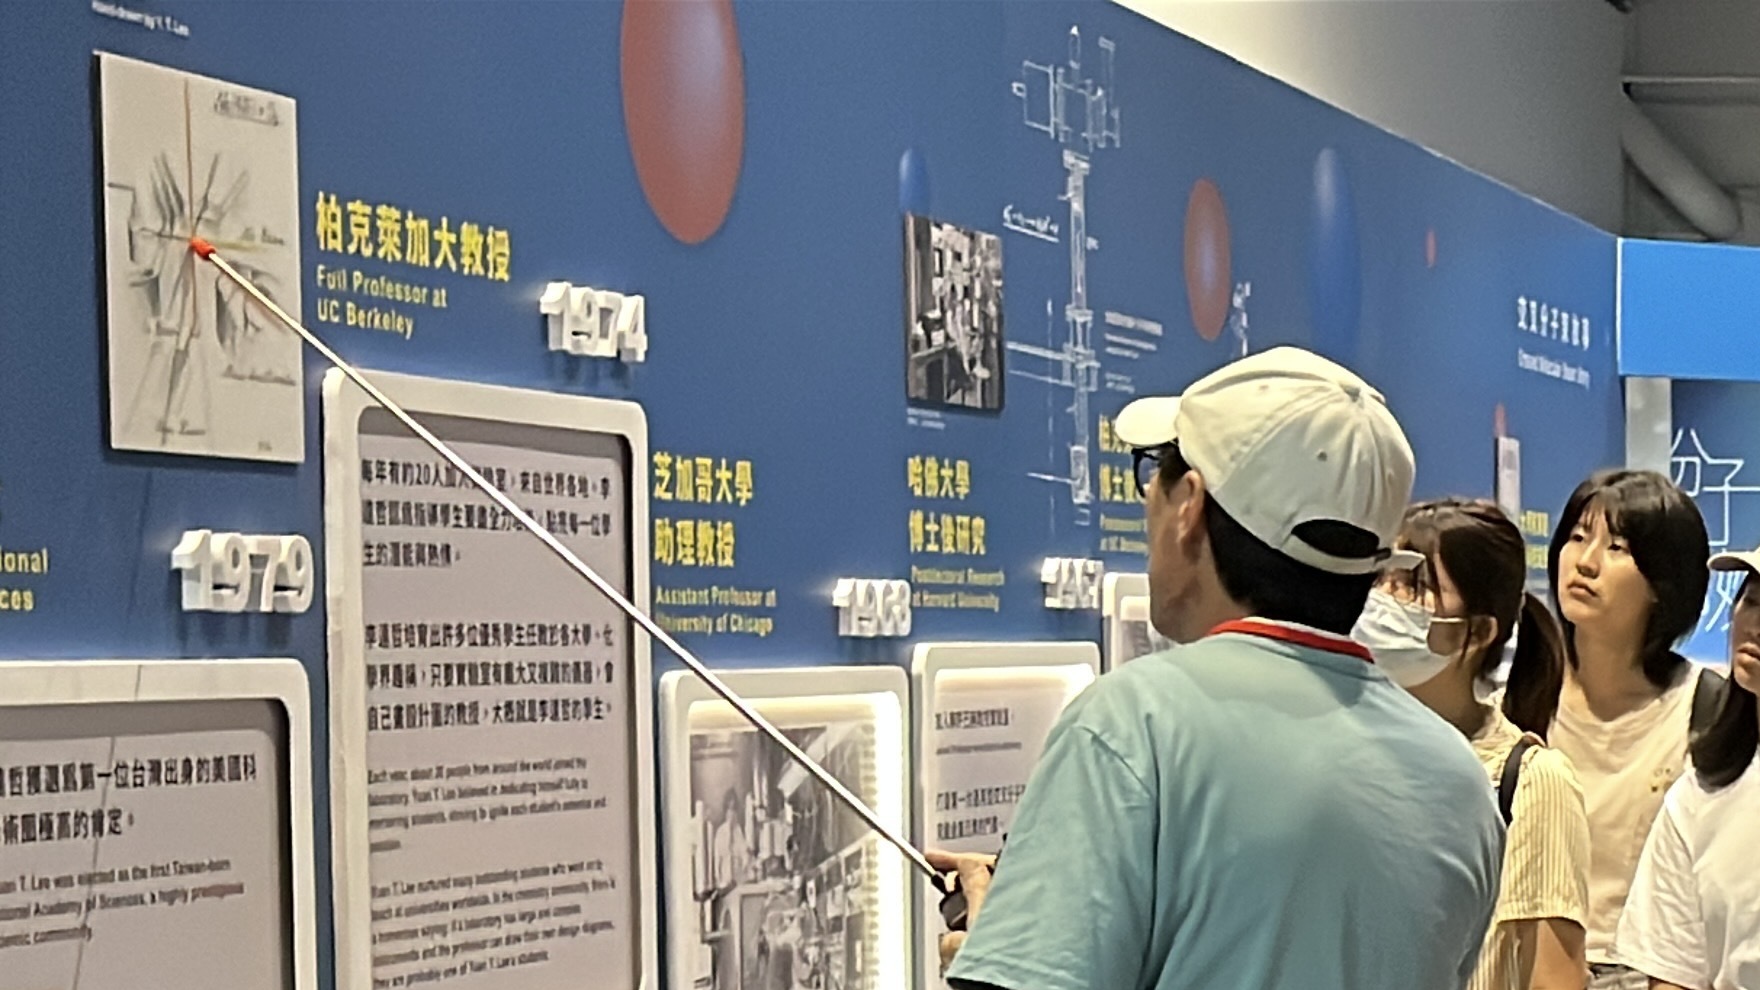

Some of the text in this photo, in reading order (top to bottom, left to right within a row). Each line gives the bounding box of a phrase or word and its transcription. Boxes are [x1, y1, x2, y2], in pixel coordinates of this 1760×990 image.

[316, 191, 511, 282] 柏克萊加大教授
[316, 264, 448, 308] Full Professor at
[316, 296, 415, 341] UC Berkeley
[540, 281, 648, 363] 1974
[653, 451, 753, 506] 芝加哥大學
[907, 454, 971, 500] 哈佛大學
[654, 517, 735, 568] 助理教授
[908, 509, 986, 556] 博士後研究
[171, 529, 314, 613] 1979
[655, 584, 777, 608] Assistant Professor at
[715, 612, 729, 633] of
[730, 613, 774, 638] Chicago
